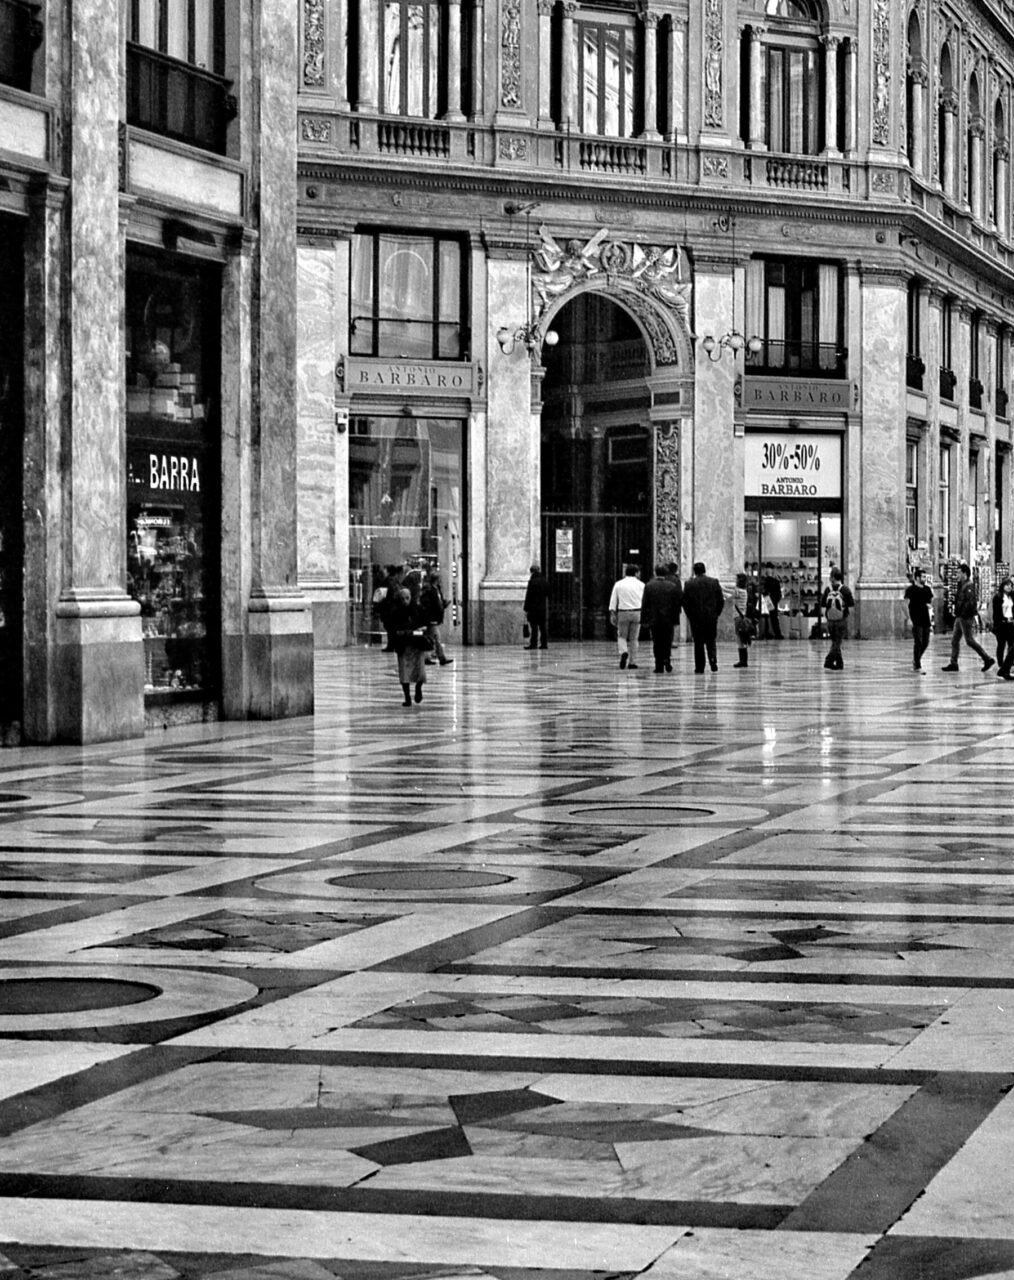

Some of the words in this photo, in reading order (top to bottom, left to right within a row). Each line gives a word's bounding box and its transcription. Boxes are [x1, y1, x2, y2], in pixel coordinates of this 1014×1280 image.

[388, 365, 436, 374] ANTONIO
[360, 371, 463, 387] BARBARO
[754, 389, 841, 403] BARBARO
[761, 442, 821, 471] 30%-50%
[149, 453, 200, 492] BARRA
[761, 484, 818, 496] BARBARO
